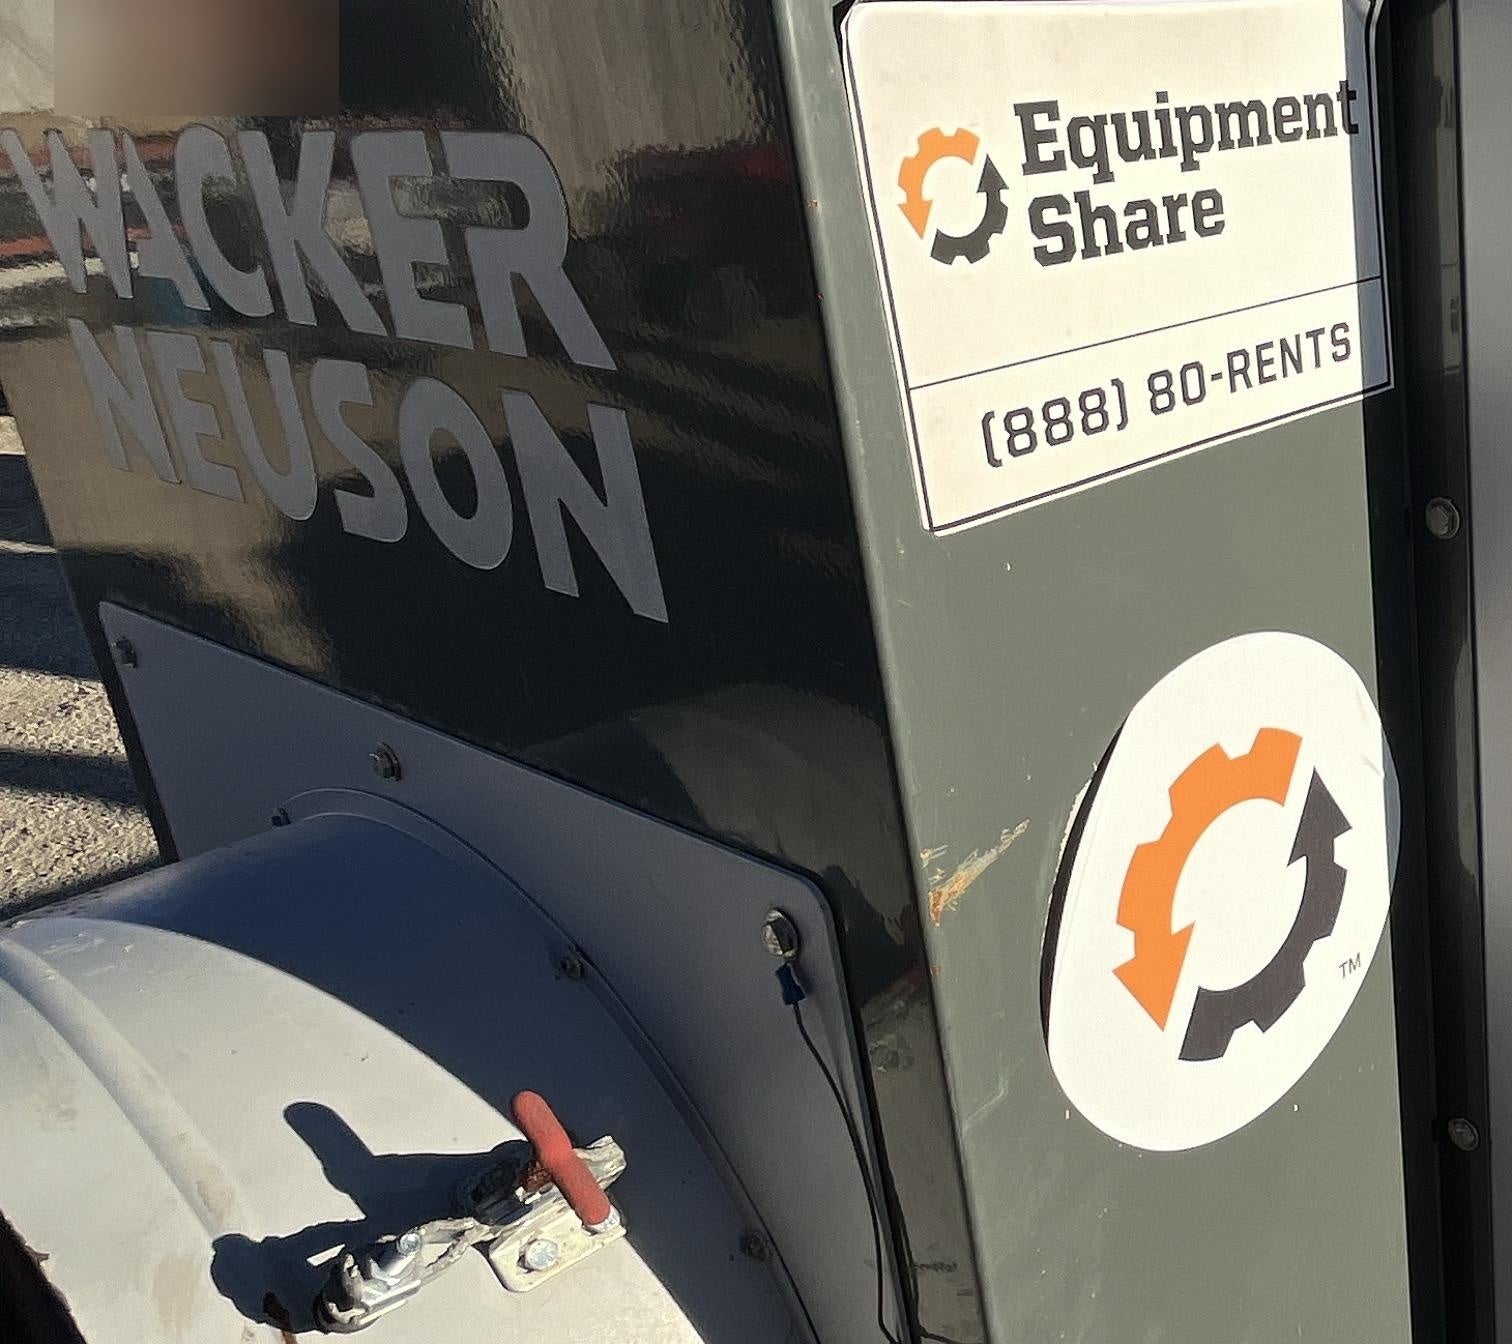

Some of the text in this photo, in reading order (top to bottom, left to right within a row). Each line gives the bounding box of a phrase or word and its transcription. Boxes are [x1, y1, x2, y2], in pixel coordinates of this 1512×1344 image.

[1012, 79, 1360, 184] Equipment
[1, 123, 618, 372] WACKER
[1027, 186, 1226, 267] Share
[980, 321, 1352, 468] (888) 80-RENTS
[68, 318, 670, 624] NEUSON
[1337, 952, 1363, 979] TM
